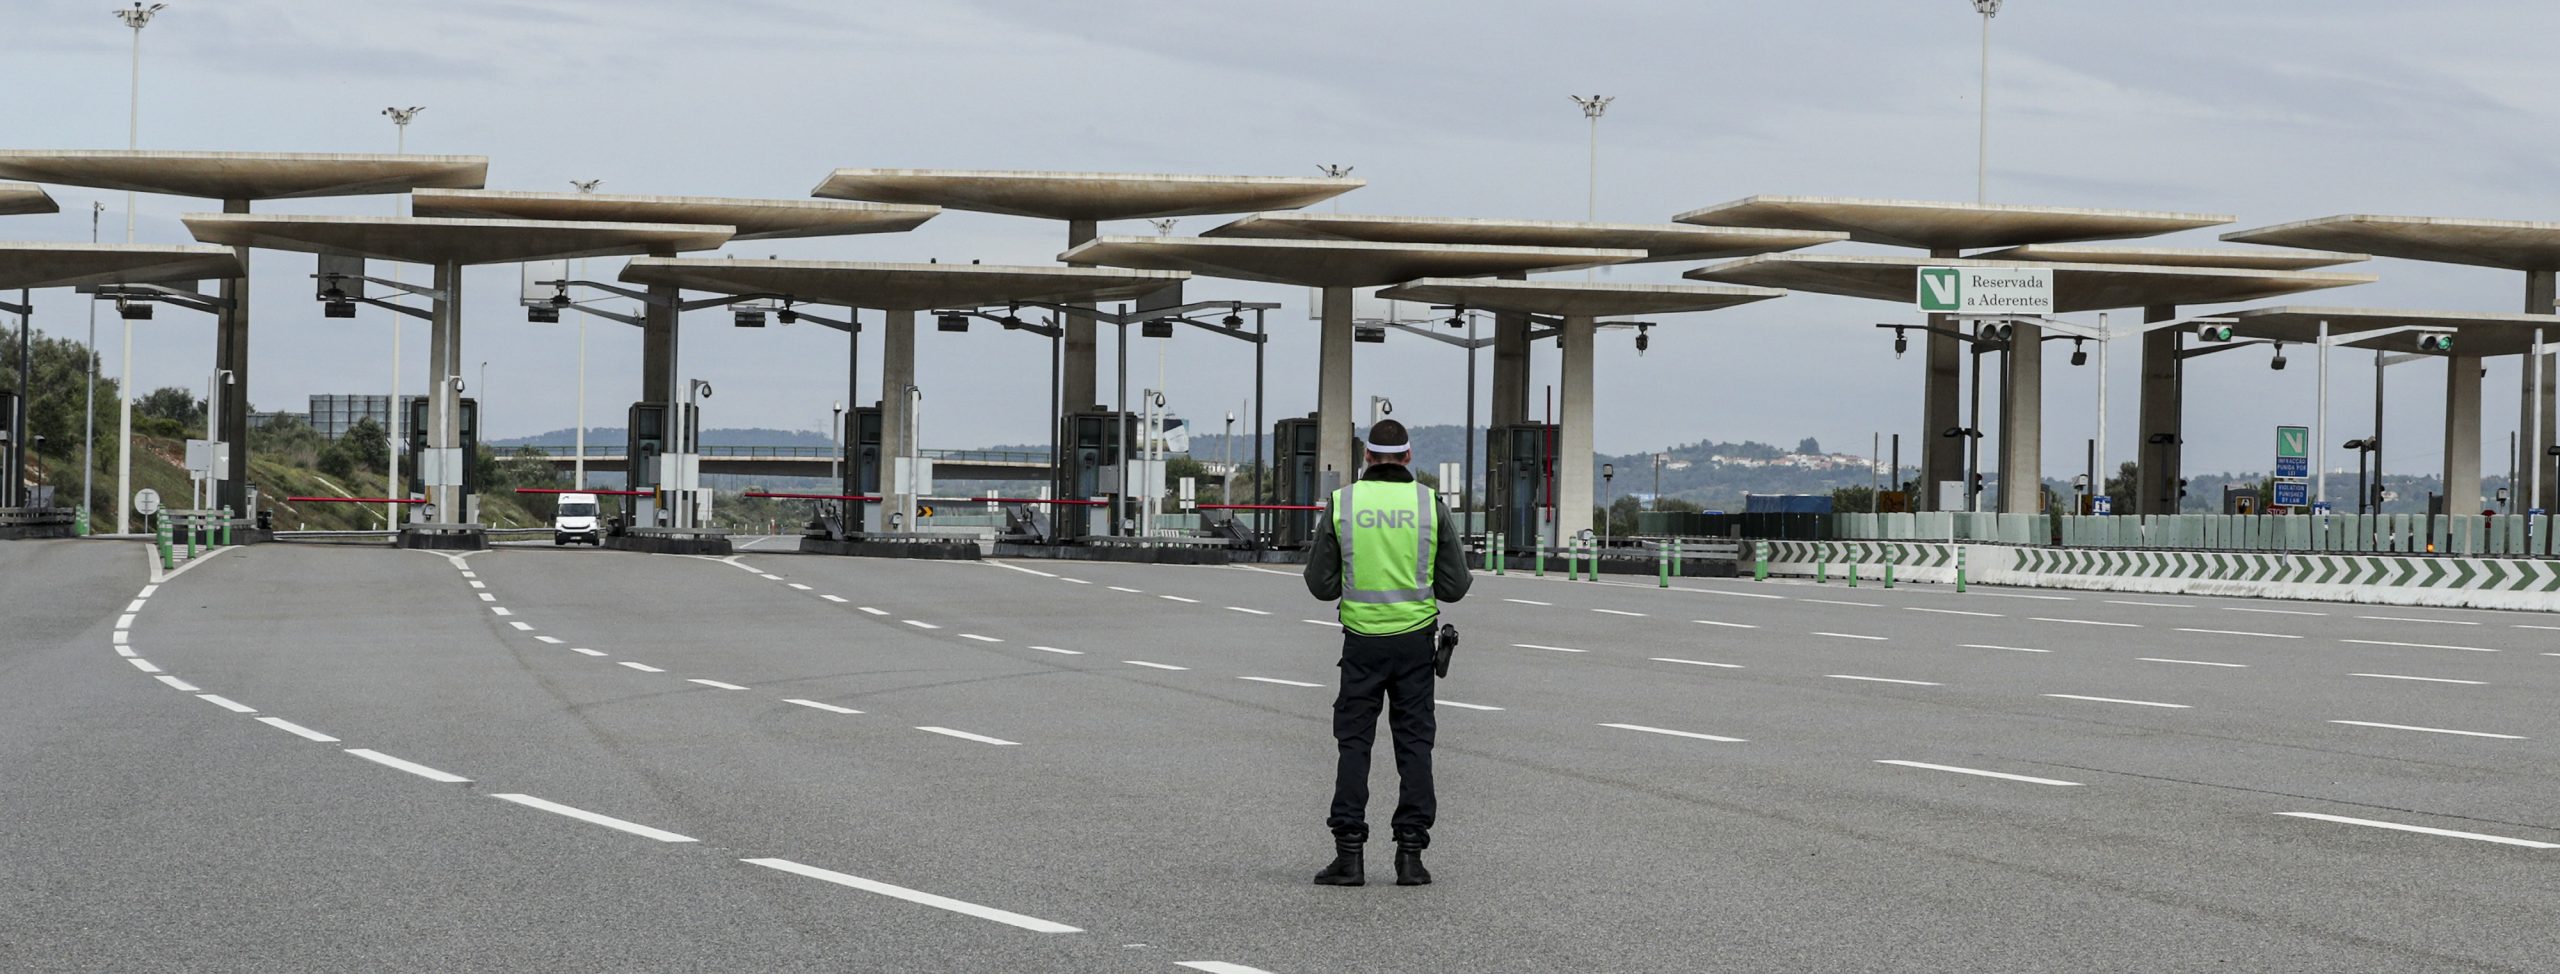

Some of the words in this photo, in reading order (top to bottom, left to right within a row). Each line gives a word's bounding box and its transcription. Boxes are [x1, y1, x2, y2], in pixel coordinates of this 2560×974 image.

[1972, 275, 2043, 288] Reservada
[1967, 297, 1975, 306] a
[1978, 294, 2049, 306] Aderentes
[1356, 509, 1415, 528] GNR
